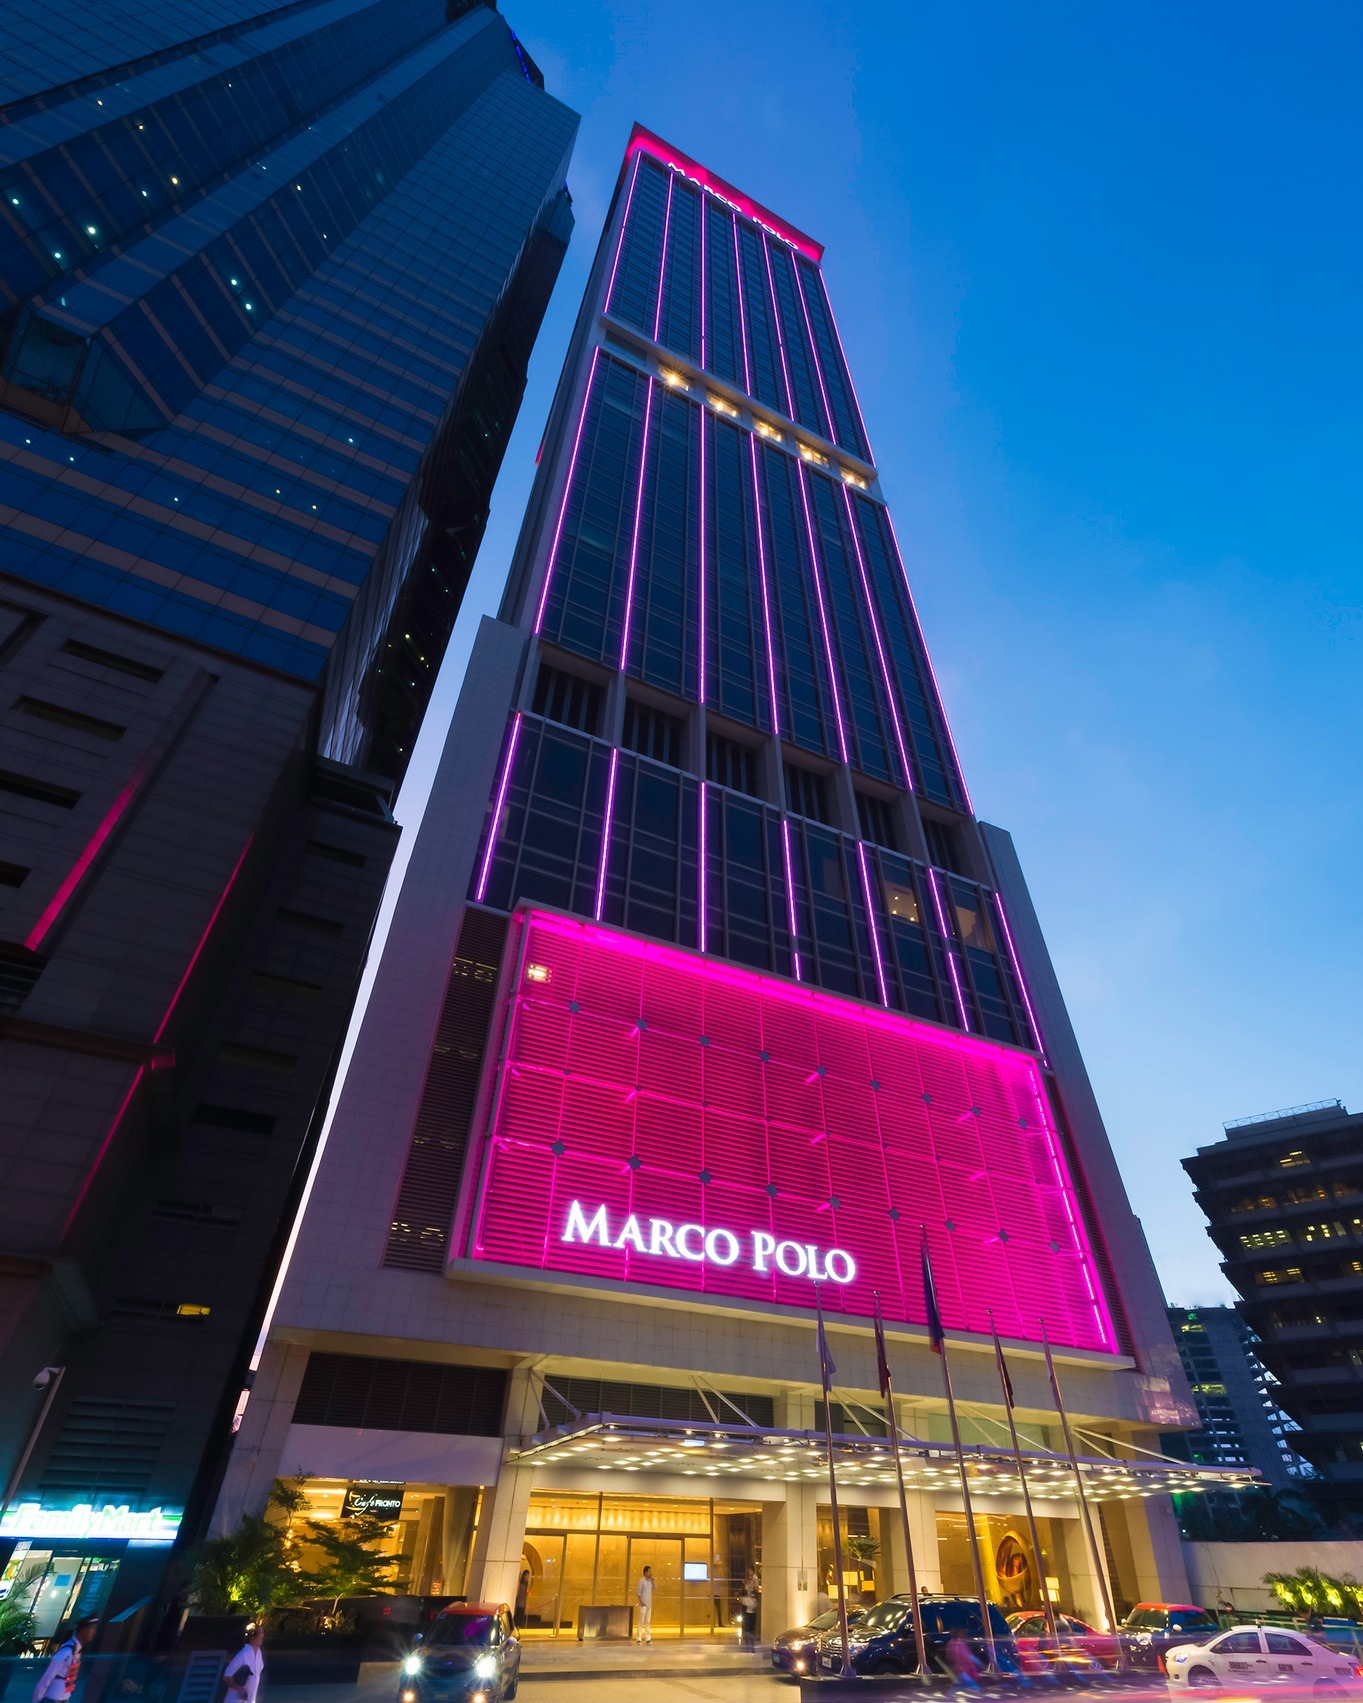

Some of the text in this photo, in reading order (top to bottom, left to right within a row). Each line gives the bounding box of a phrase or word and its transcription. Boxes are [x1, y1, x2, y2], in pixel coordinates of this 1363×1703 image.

[561, 1199, 856, 1283] MARCO POLO
[13, 1503, 162, 1538] FamilyMart
[375, 1500, 401, 1508] PRONTO
